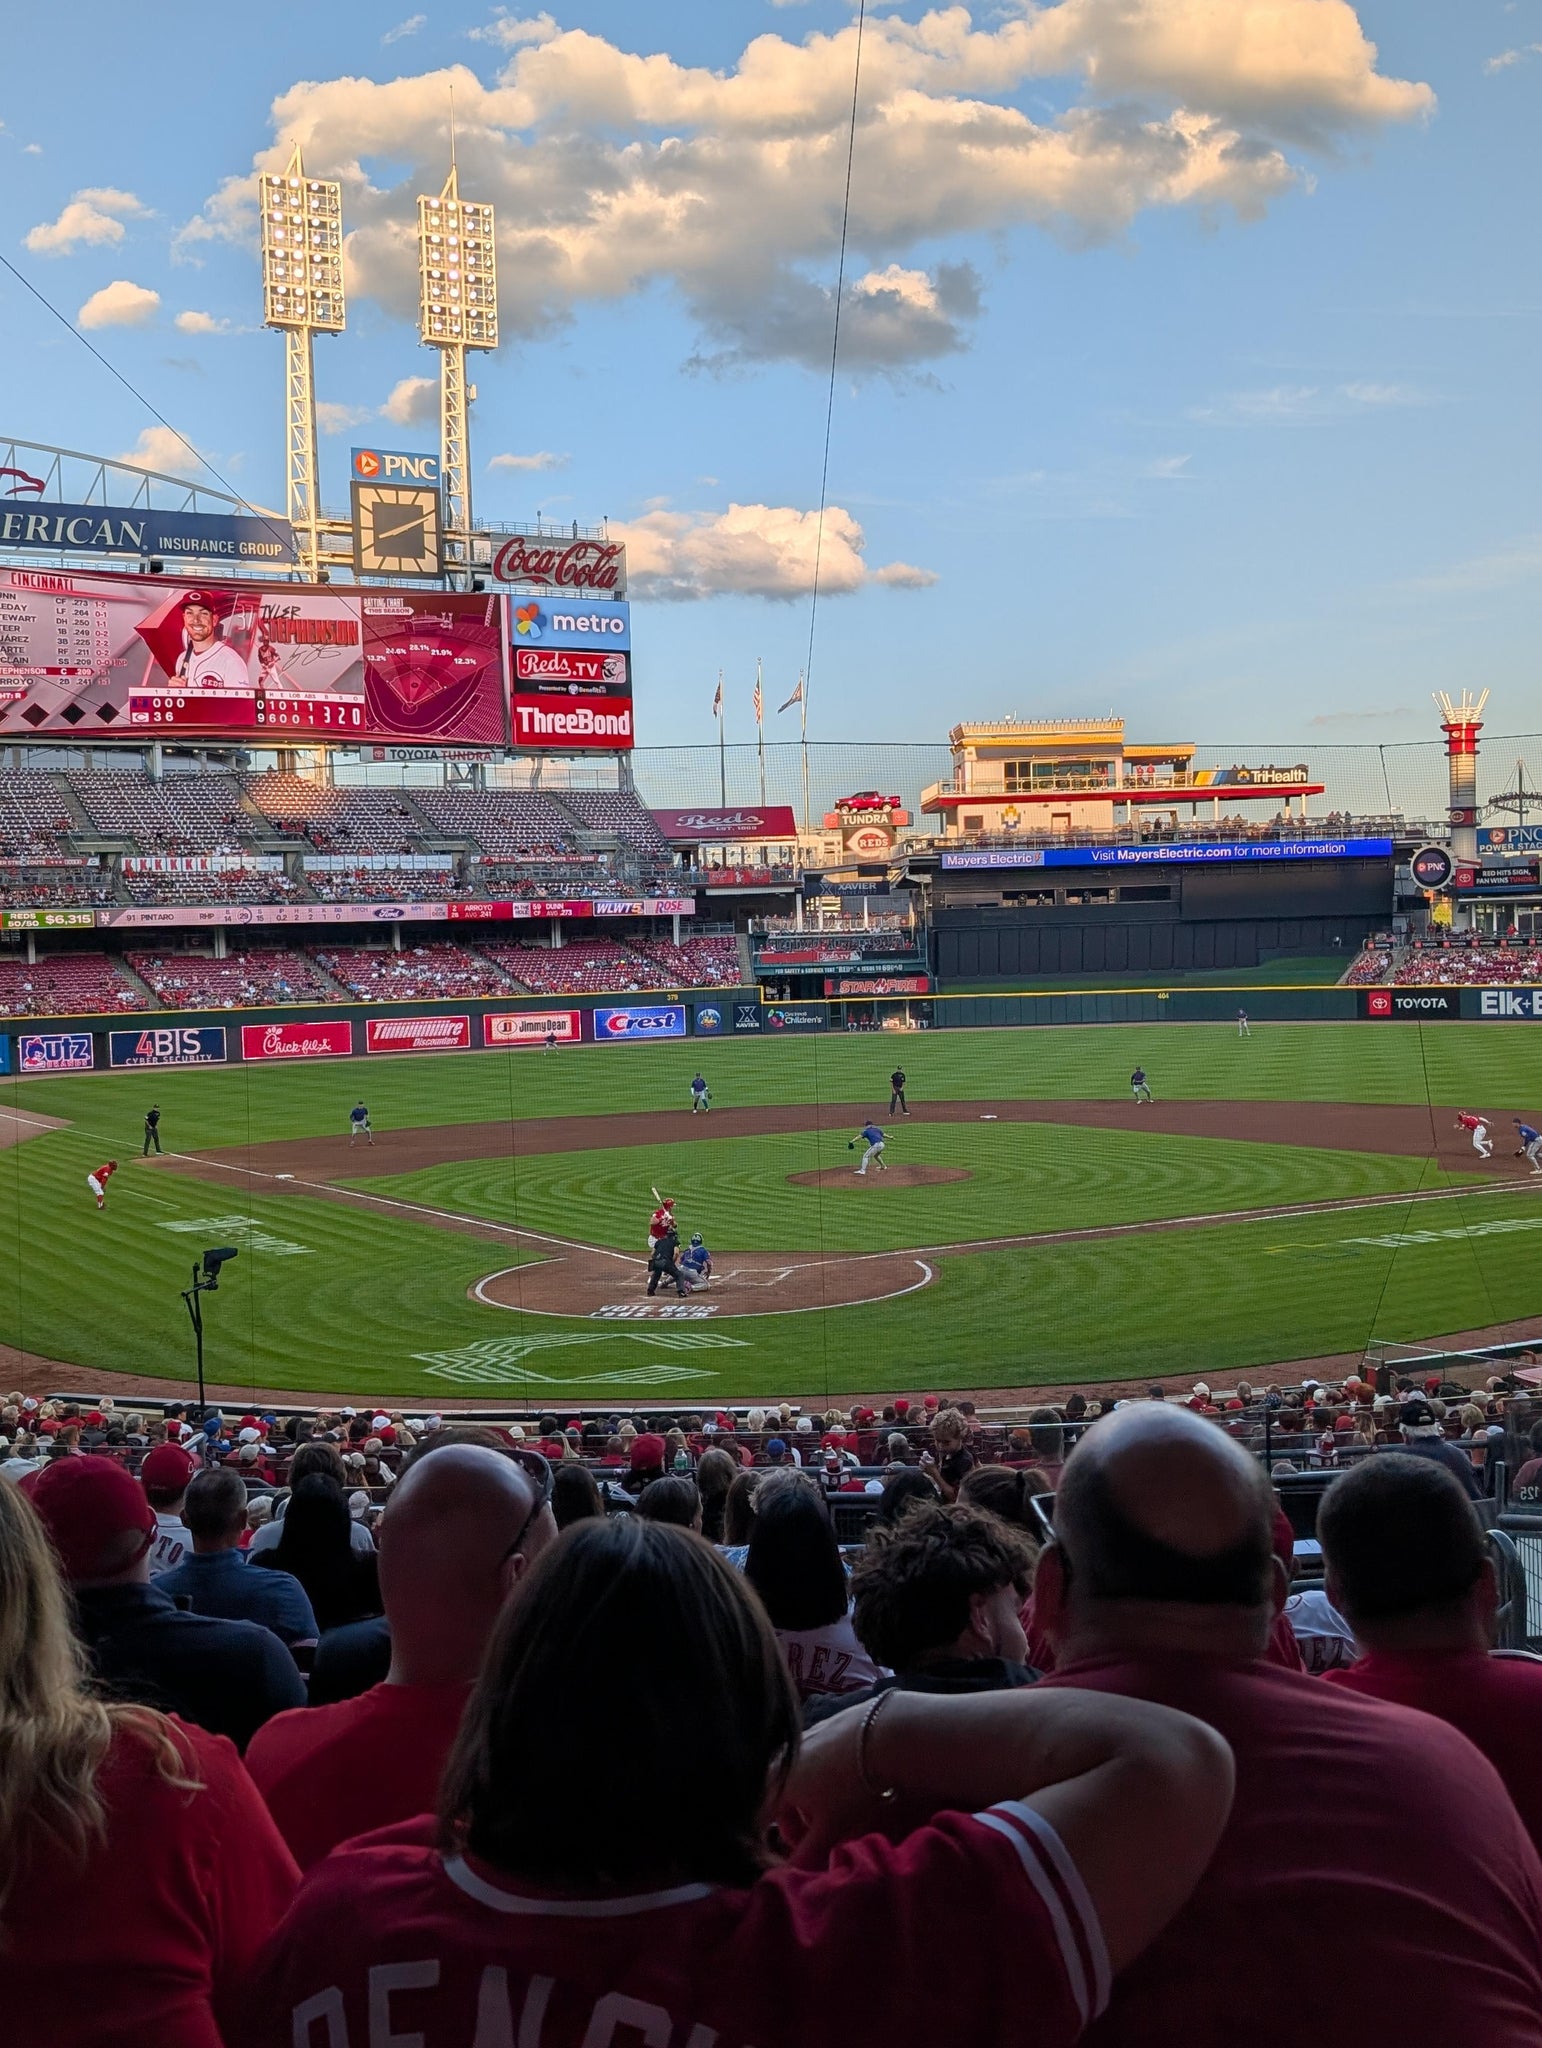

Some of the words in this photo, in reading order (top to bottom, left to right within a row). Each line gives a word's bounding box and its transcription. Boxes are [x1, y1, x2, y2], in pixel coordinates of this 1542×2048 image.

[383, 454, 438, 481] PNC
[159, 537, 235, 554] INSURANCE
[239, 542, 282, 557] GROUP
[493, 537, 625, 590] Coca-Cola
[11, 572, 73, 591] CINCINNATI
[56, 607, 67, 615] LF
[553, 614, 624, 634] metro
[153, 698, 161, 708] 0
[165, 698, 173, 708] 0
[176, 698, 185, 708] 0
[257, 700, 265, 710] 0
[269, 700, 275, 710] 1
[279, 701, 287, 711] 0
[292, 701, 298, 711] 1
[308, 702, 313, 712] 1
[153, 712, 161, 722] 3
[165, 712, 173, 722] 6
[257, 713, 265, 723] 9
[269, 713, 276, 723] 6
[279, 714, 287, 723] 0
[292, 714, 300, 724] 0
[308, 715, 314, 725] 1
[323, 706, 331, 724] 3
[338, 707, 346, 725] 2
[352, 708, 360, 725] 0
[516, 707, 630, 736] ThreeBond
[390, 749, 439, 761] TOYOTA
[1251, 769, 1307, 784] TriHealth
[675, 811, 765, 830] Reds
[842, 814, 889, 825] TUNDRA
[859, 837, 890, 848] REDS
[1479, 844, 1515, 852] POWER
[1092, 850, 1115, 862] Visit
[1117, 846, 1232, 862] MayersElectric.com
[1233, 844, 1250, 856] for
[1251, 846, 1273, 856] more
[1275, 842, 1346, 855] information
[139, 859, 147, 870] K
[154, 859, 163, 870] K
[170, 859, 179, 870] K
[185, 859, 193, 870] K
[200, 859, 208, 869] K
[947, 855, 988, 867] Mayers
[990, 853, 1032, 865] Electric
[1427, 863, 1445, 872] PNC
[378, 908, 399, 918] Ford
[655, 901, 683, 914] ROSE
[45, 914, 91, 925] $6,315
[200, 912, 215, 921] RHP
[1395, 998, 1448, 1009] TOYOTA
[607, 1012, 676, 1031] Crest
[135, 1029, 201, 1057] 4BIS
[126, 1056, 158, 1065] CYBER
[163, 1053, 212, 1063] SECURITY
[600, 1305, 658, 1313] VOTE
